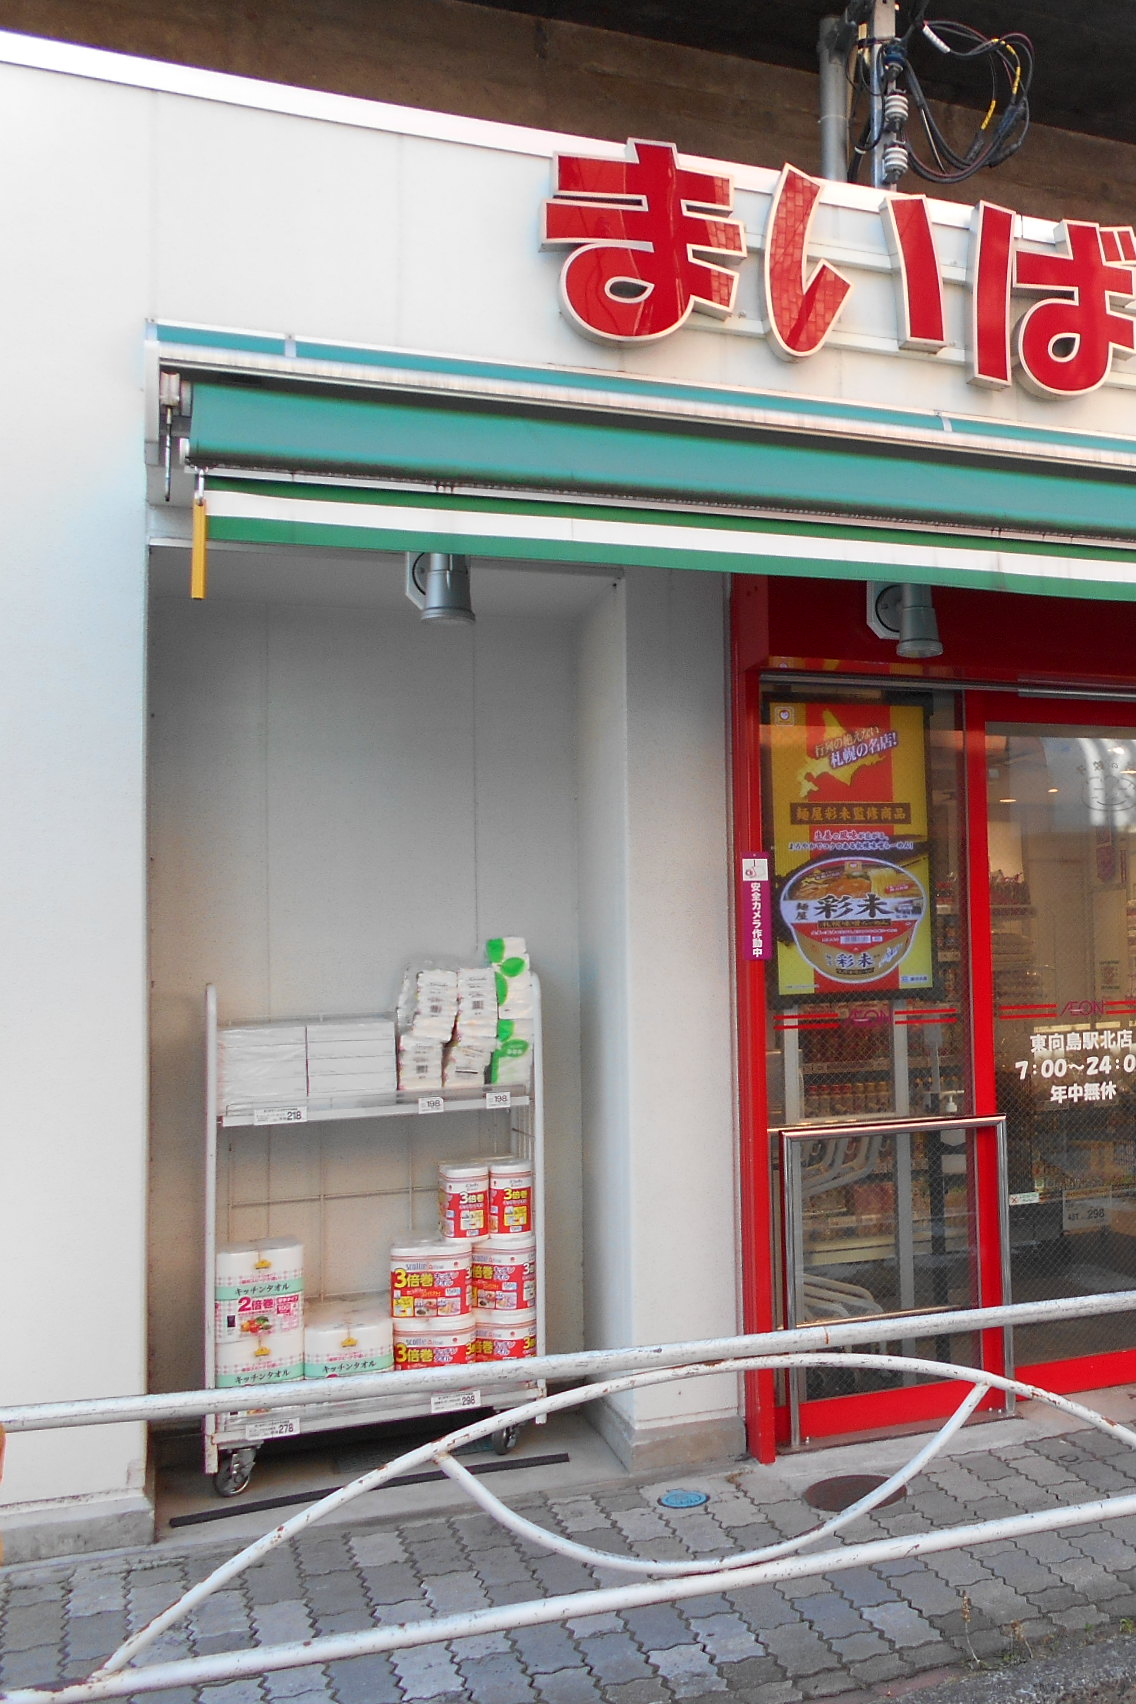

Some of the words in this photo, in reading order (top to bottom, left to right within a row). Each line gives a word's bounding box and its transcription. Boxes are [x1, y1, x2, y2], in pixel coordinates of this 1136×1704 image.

[750, 882, 763, 957] 安全カメラ作動中
[1030, 1030, 1133, 1053] 東向島駅北店
[1050, 1081, 1117, 1104] 年中無休
[427, 1099, 441, 1108] 198
[394, 1267, 434, 1288] 3倍巻
[235, 1282, 290, 1297] キッチンタオル
[238, 1296, 275, 1312] 2倍巻
[395, 1343, 434, 1363] 3倍巻
[323, 1360, 377, 1373] キッチンタオル
[235, 1370, 290, 1384] キッチンタオル
